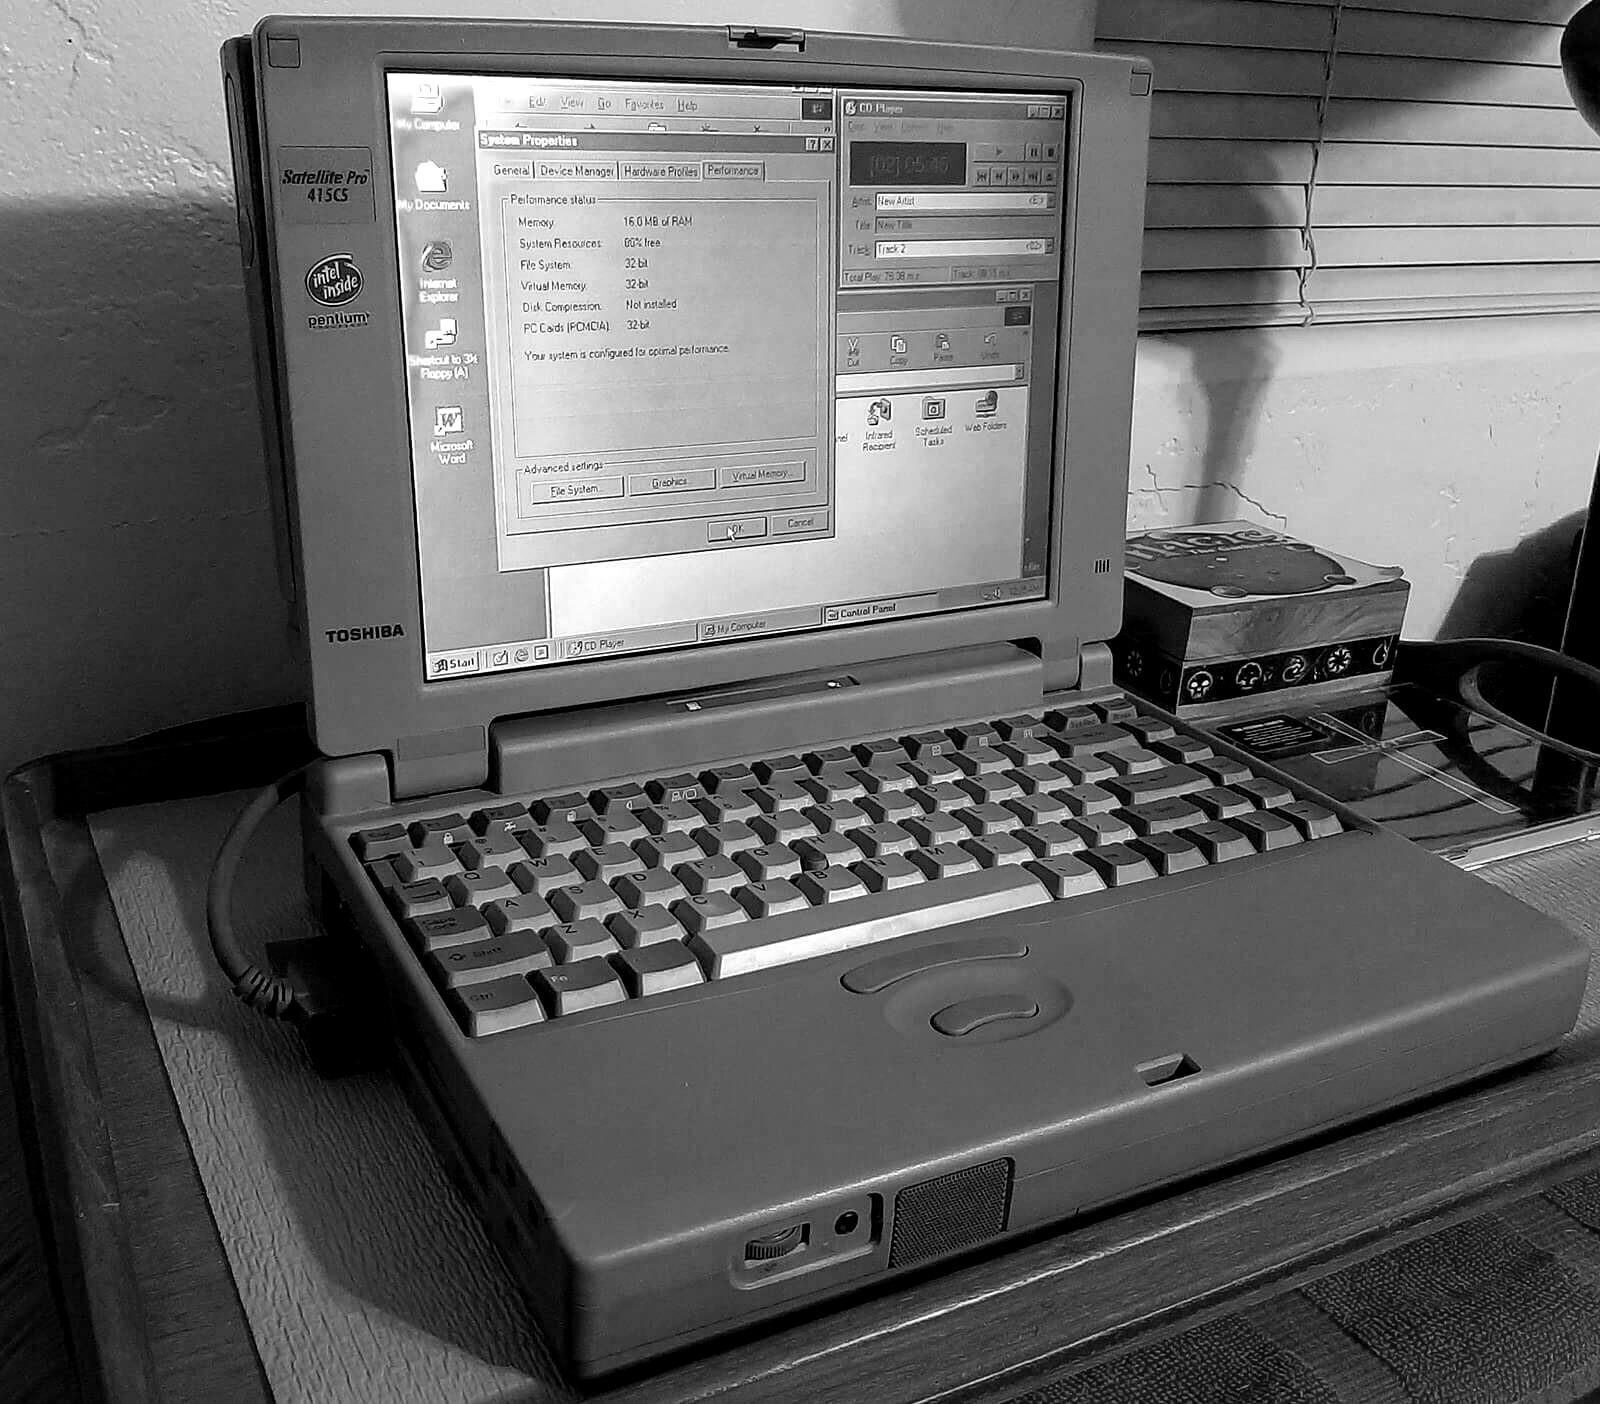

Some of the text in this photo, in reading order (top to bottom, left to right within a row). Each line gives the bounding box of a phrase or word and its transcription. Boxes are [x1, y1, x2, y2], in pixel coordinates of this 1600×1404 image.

[560, 97, 585, 109] View
[598, 98, 612, 110] Go
[624, 98, 665, 112] Favorites
[677, 99, 699, 113] Help
[480, 133, 578, 149] System Properties
[282, 168, 344, 185] Satellite
[494, 164, 531, 177] General
[540, 165, 615, 180] Device Manager
[624, 166, 699, 179] Hardware Profiles
[707, 164, 760, 178] Performance
[307, 187, 350, 203] 415CS
[510, 194, 597, 206] Performance status
[877, 196, 896, 206] New
[414, 200, 471, 212] Documents
[624, 216, 693, 228] 16.0 MB of RAM
[520, 238, 552, 251] System
[644, 237, 661, 248] free
[877, 244, 899, 256] Track
[520, 260, 536, 271] File
[312, 261, 342, 289] intel
[322, 275, 360, 300] inside
[419, 277, 458, 291] Internet
[520, 281, 550, 292] Virtual
[419, 291, 459, 304] Explorer
[626, 299, 678, 311] Not installed
[308, 312, 370, 329] pentium
[523, 322, 538, 334] PC
[451, 354, 462, 365] to
[524, 351, 547, 363] Your
[548, 350, 578, 363] system
[589, 347, 634, 361] configured
[635, 346, 646, 358] for
[648, 346, 678, 358] optimal
[847, 358, 860, 368] Cut
[420, 367, 454, 380] Floppy
[915, 425, 953, 437] Scheduled
[965, 422, 1008, 433] Web Folders
[865, 430, 893, 442] Infrared
[430, 437, 474, 452] Microsoft
[862, 440, 897, 453] Recipient
[923, 438, 945, 449] Tasks
[438, 453, 467, 466] Word
[524, 461, 604, 475] Advanced settings
[733, 471, 756, 483] Virtual
[551, 484, 566, 496] File
[787, 517, 814, 529] Cancel
[840, 603, 896, 619] Control Panel
[730, 619, 767, 633] Computer
[325, 624, 405, 643] TOSHIBA
[584, 638, 625, 652] CD Player
[450, 658, 475, 671] Start
